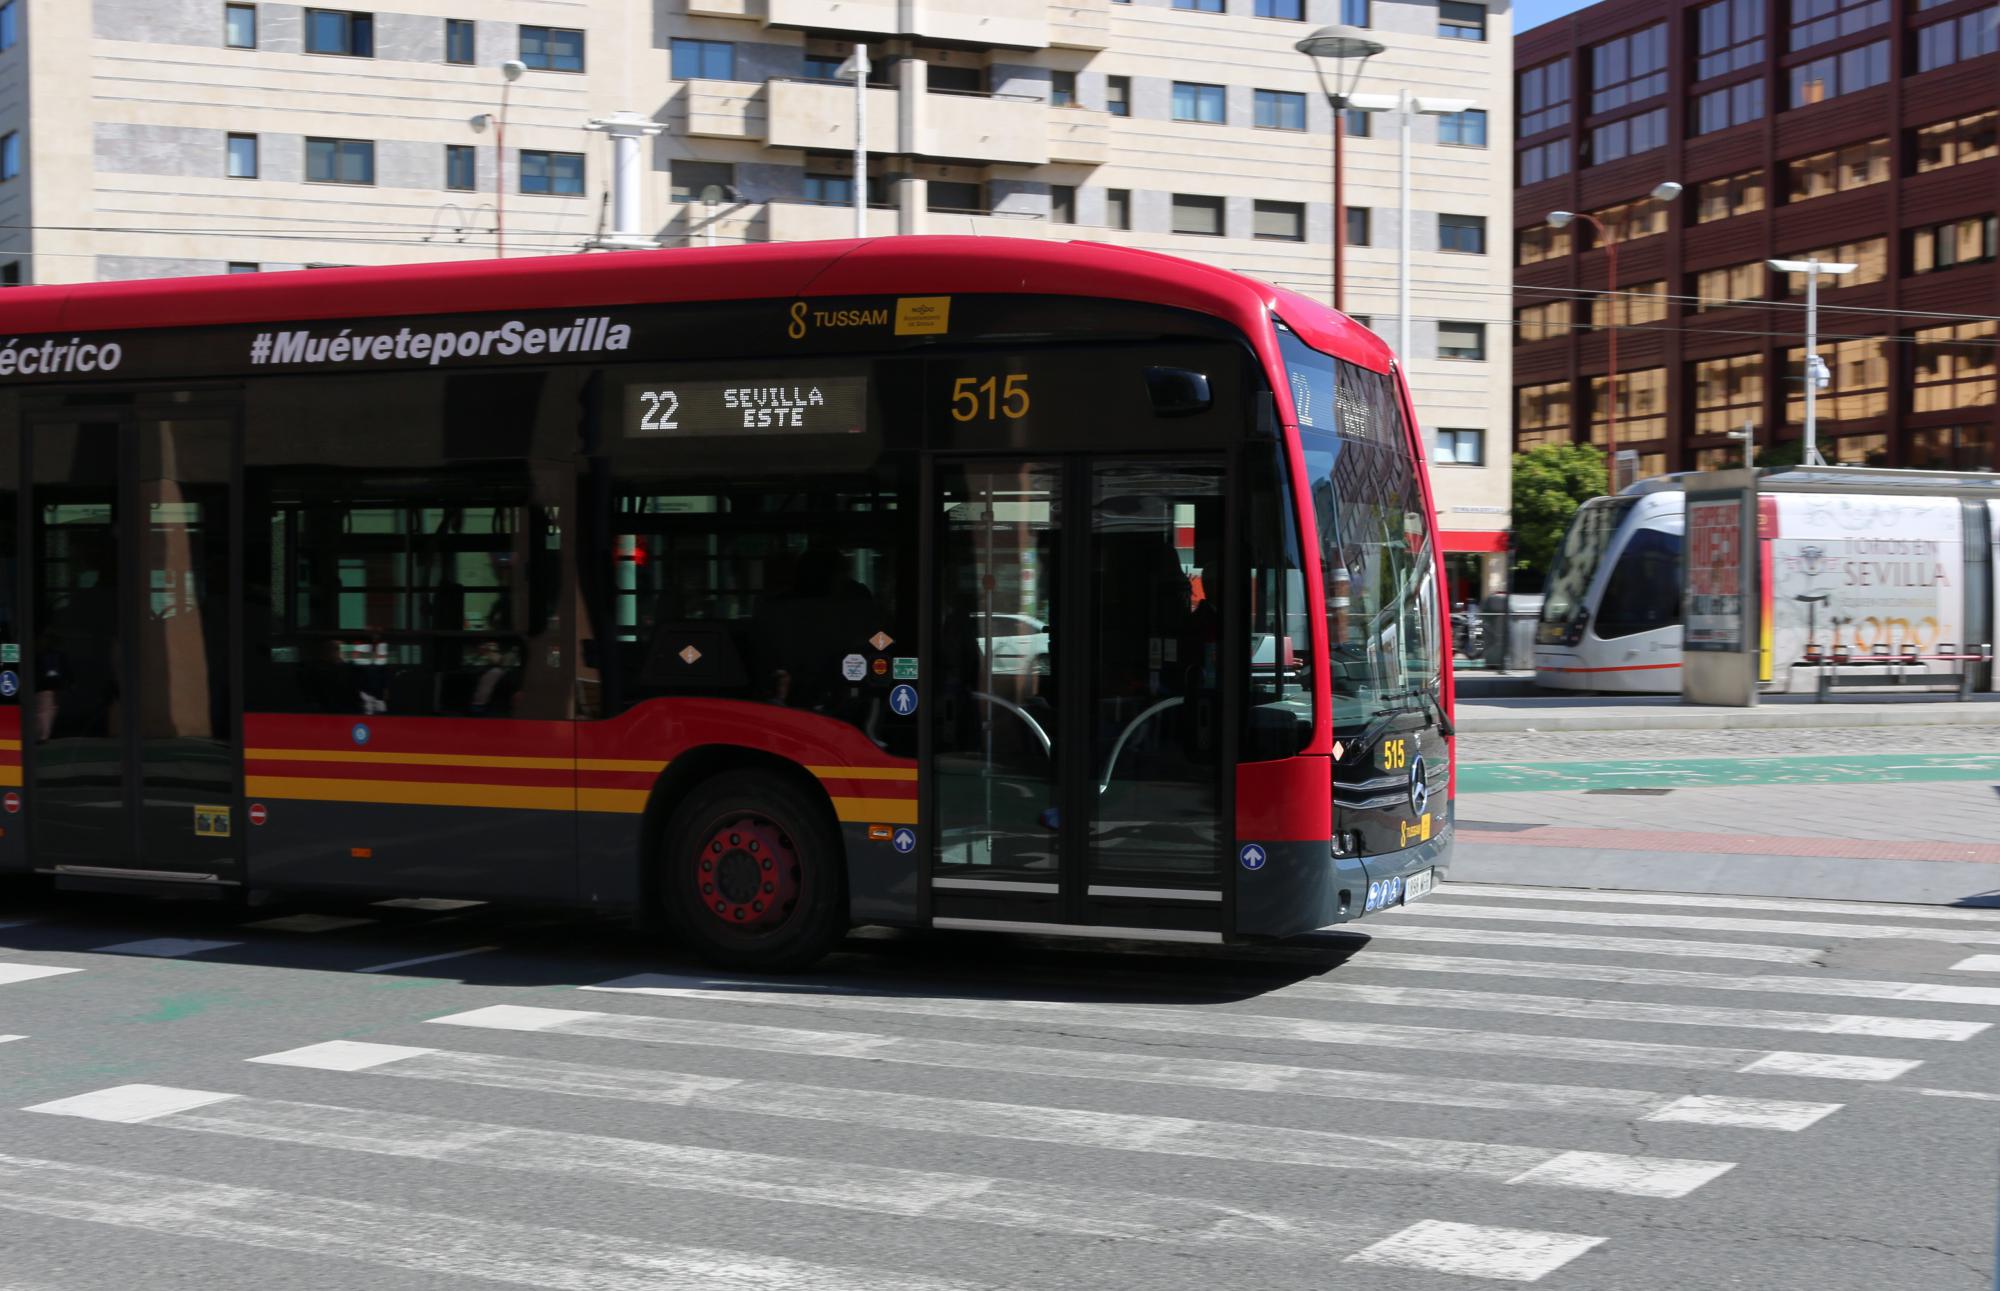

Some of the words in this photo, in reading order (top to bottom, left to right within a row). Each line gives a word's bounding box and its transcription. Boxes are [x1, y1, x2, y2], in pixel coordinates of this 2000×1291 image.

[813, 310, 888, 327] TUSSAM
[0, 337, 122, 375] éctrico
[250, 316, 631, 366] #MuéveteporSevilla
[640, 391, 679, 430] 22
[723, 387, 824, 408] SEVILLA
[951, 374, 1030, 421] 515
[743, 408, 804, 428] ESTE
[1843, 561, 1953, 588] SEVILLA
[1384, 739, 1405, 770] 515
